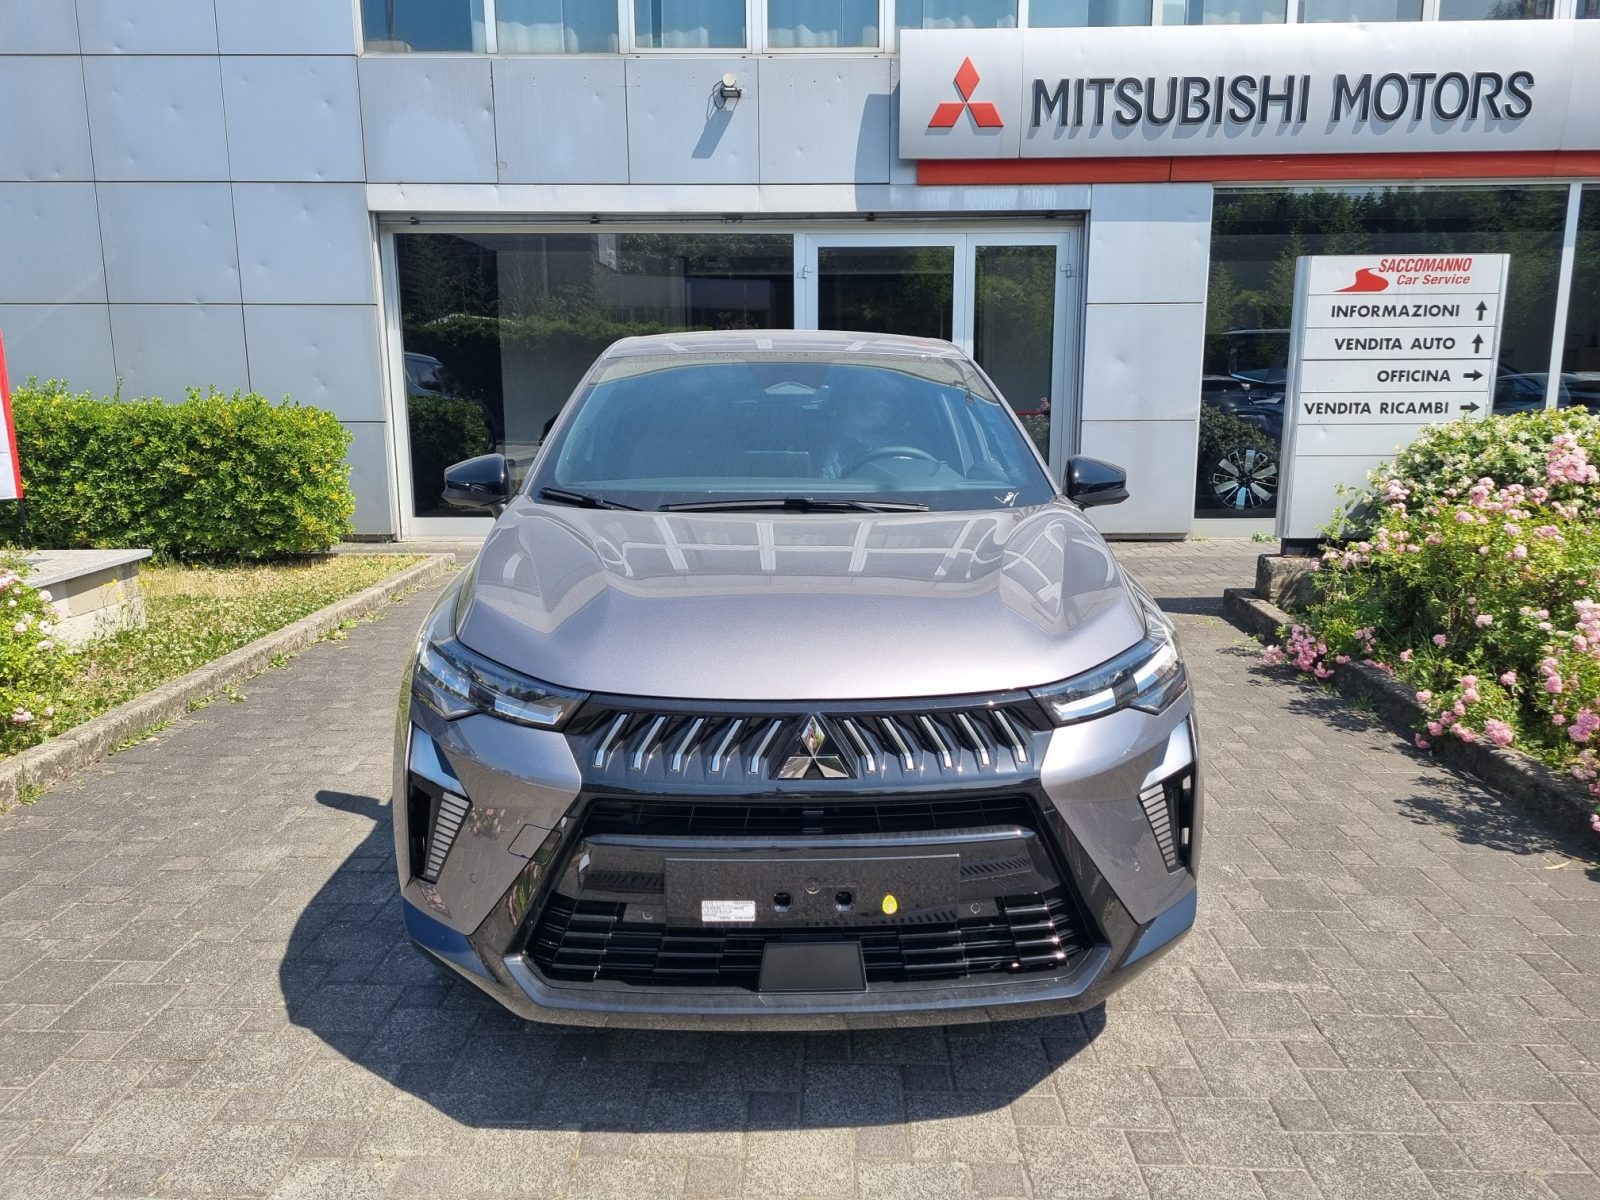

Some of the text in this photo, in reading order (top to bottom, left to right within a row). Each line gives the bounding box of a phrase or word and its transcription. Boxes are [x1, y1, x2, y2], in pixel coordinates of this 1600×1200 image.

[1032, 70, 1535, 128] MITSUBISHI MOTORS
[1378, 258, 1472, 272] SACCOMANNO
[1396, 274, 1471, 285] Car Service
[1331, 304, 1460, 318] INFORMAZIONI
[1334, 337, 1456, 350] VENDITA AUTO
[1377, 370, 1451, 382] OFFICINA
[1304, 402, 1449, 414] VENDITA RICAMBI
